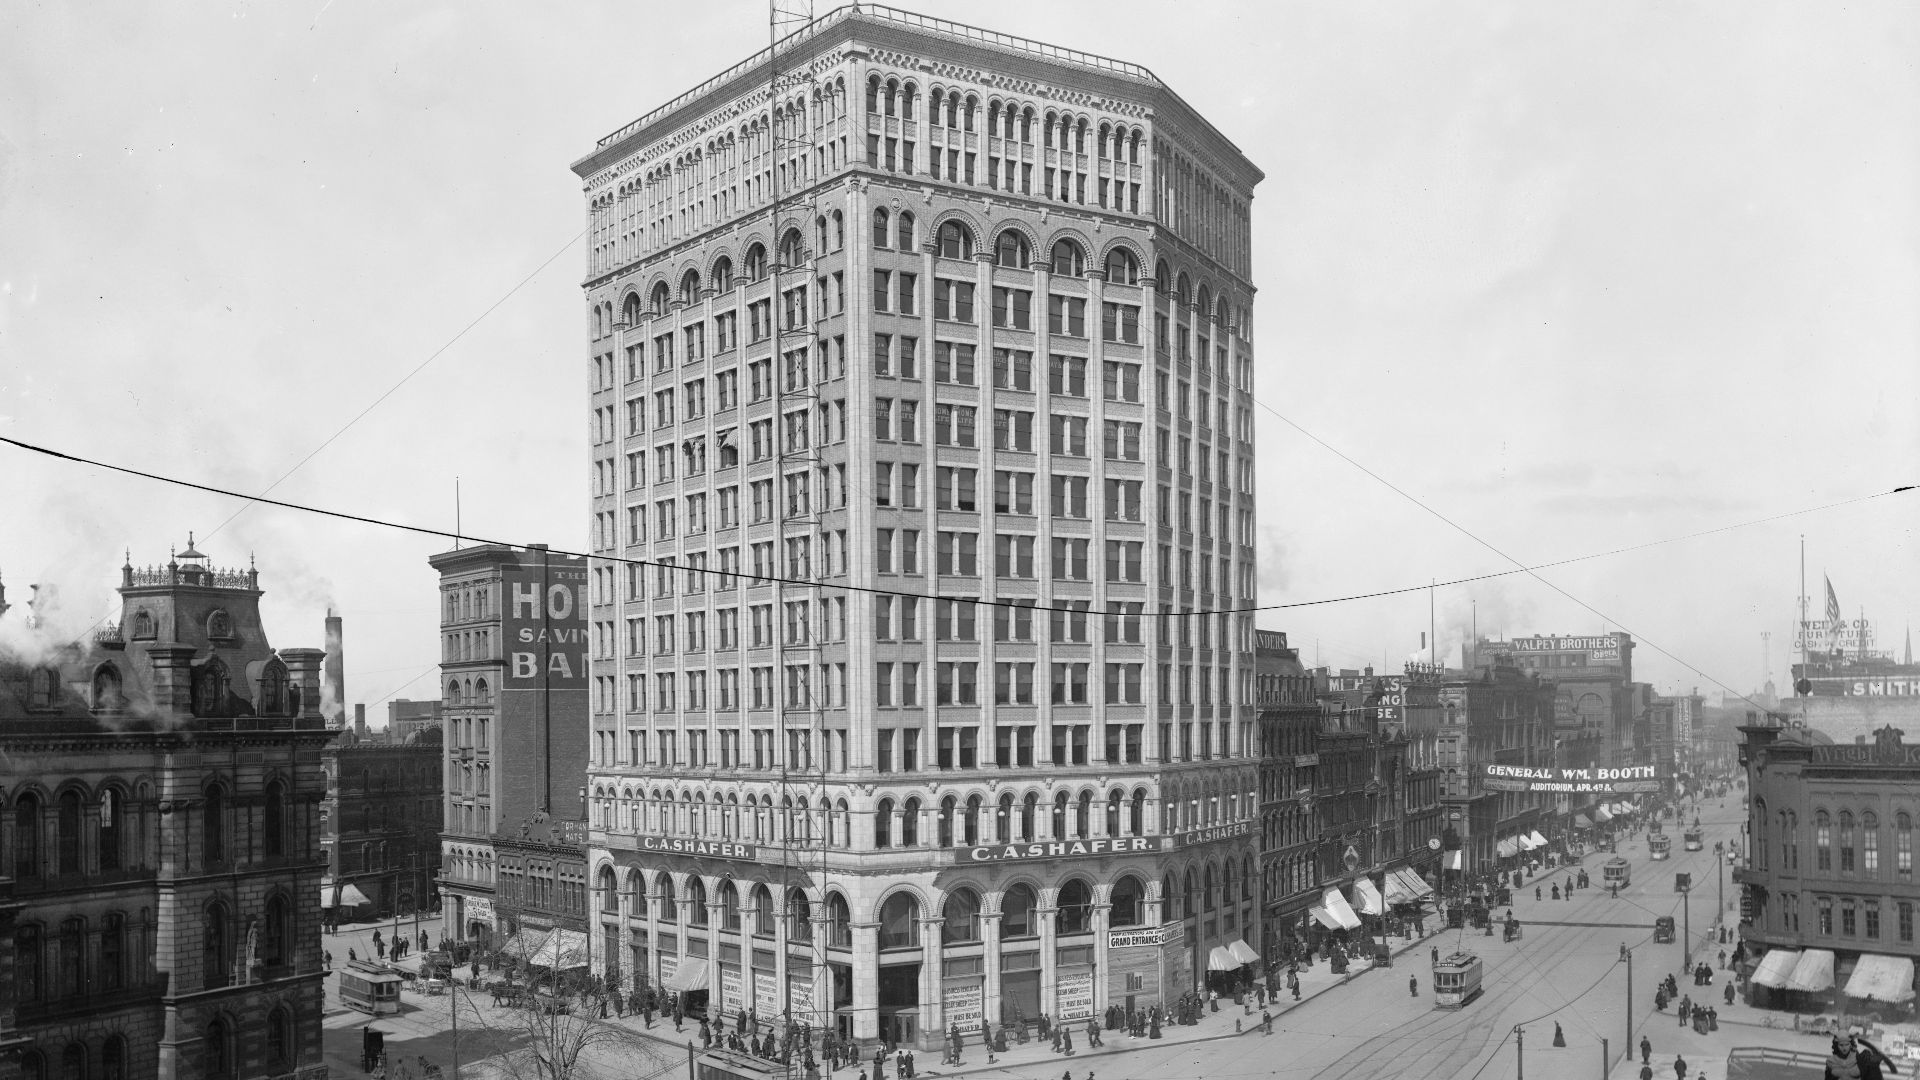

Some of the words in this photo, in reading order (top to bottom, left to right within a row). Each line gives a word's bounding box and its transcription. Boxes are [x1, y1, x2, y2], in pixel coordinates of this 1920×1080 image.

[1798, 630, 1872, 639] FURTURE
[1255, 633, 1286, 650] ANDERS
[1515, 639, 1556, 650] VALPEY
[1560, 637, 1617, 650] BROTHERS
[1838, 639, 1875, 648] CREIT
[1377, 708, 1397, 719] SE.
[1487, 764, 1553, 779] GENERAL
[1561, 769, 1591, 780] WM.
[1597, 765, 1655, 780] BOOTH
[1111, 936, 1131, 947] GRAND
[1132, 935, 1159, 945] ENTRANCE
